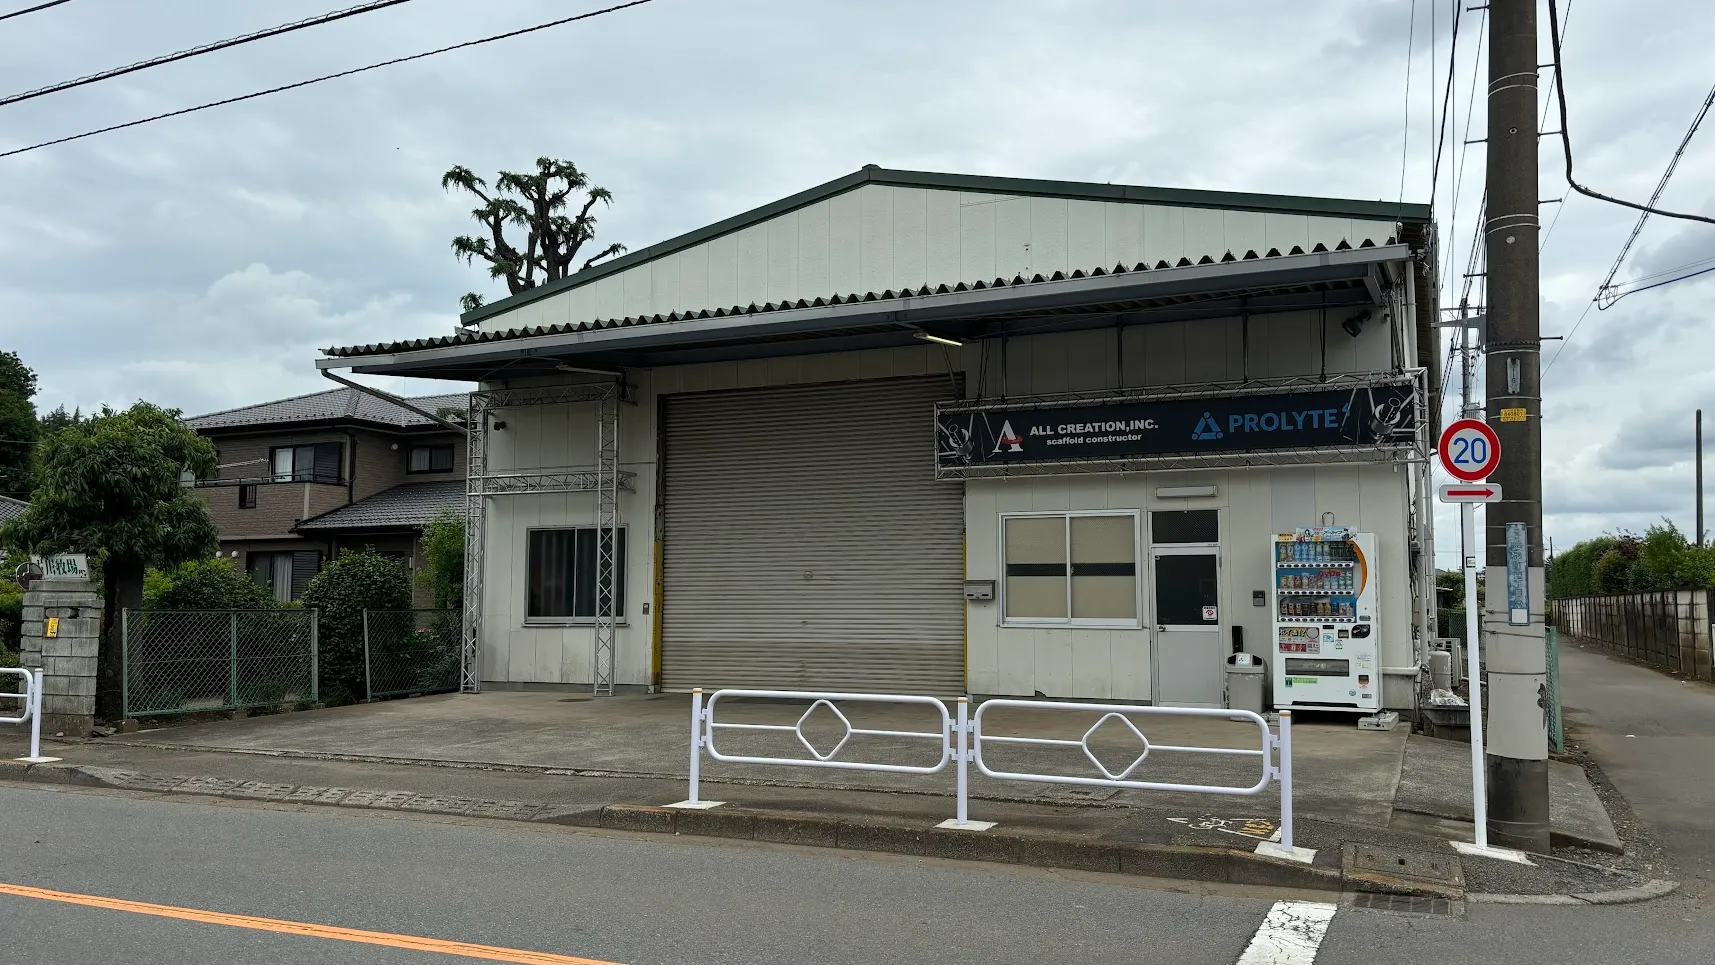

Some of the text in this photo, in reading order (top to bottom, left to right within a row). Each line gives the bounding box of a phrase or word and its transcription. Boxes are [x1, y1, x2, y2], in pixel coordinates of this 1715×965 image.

[1029, 419, 1159, 436] ALL CREATION,INC.
[1228, 408, 1339, 433] PROLYTE
[1046, 433, 1143, 446] scaffold constructor
[1453, 437, 1487, 464] 20
